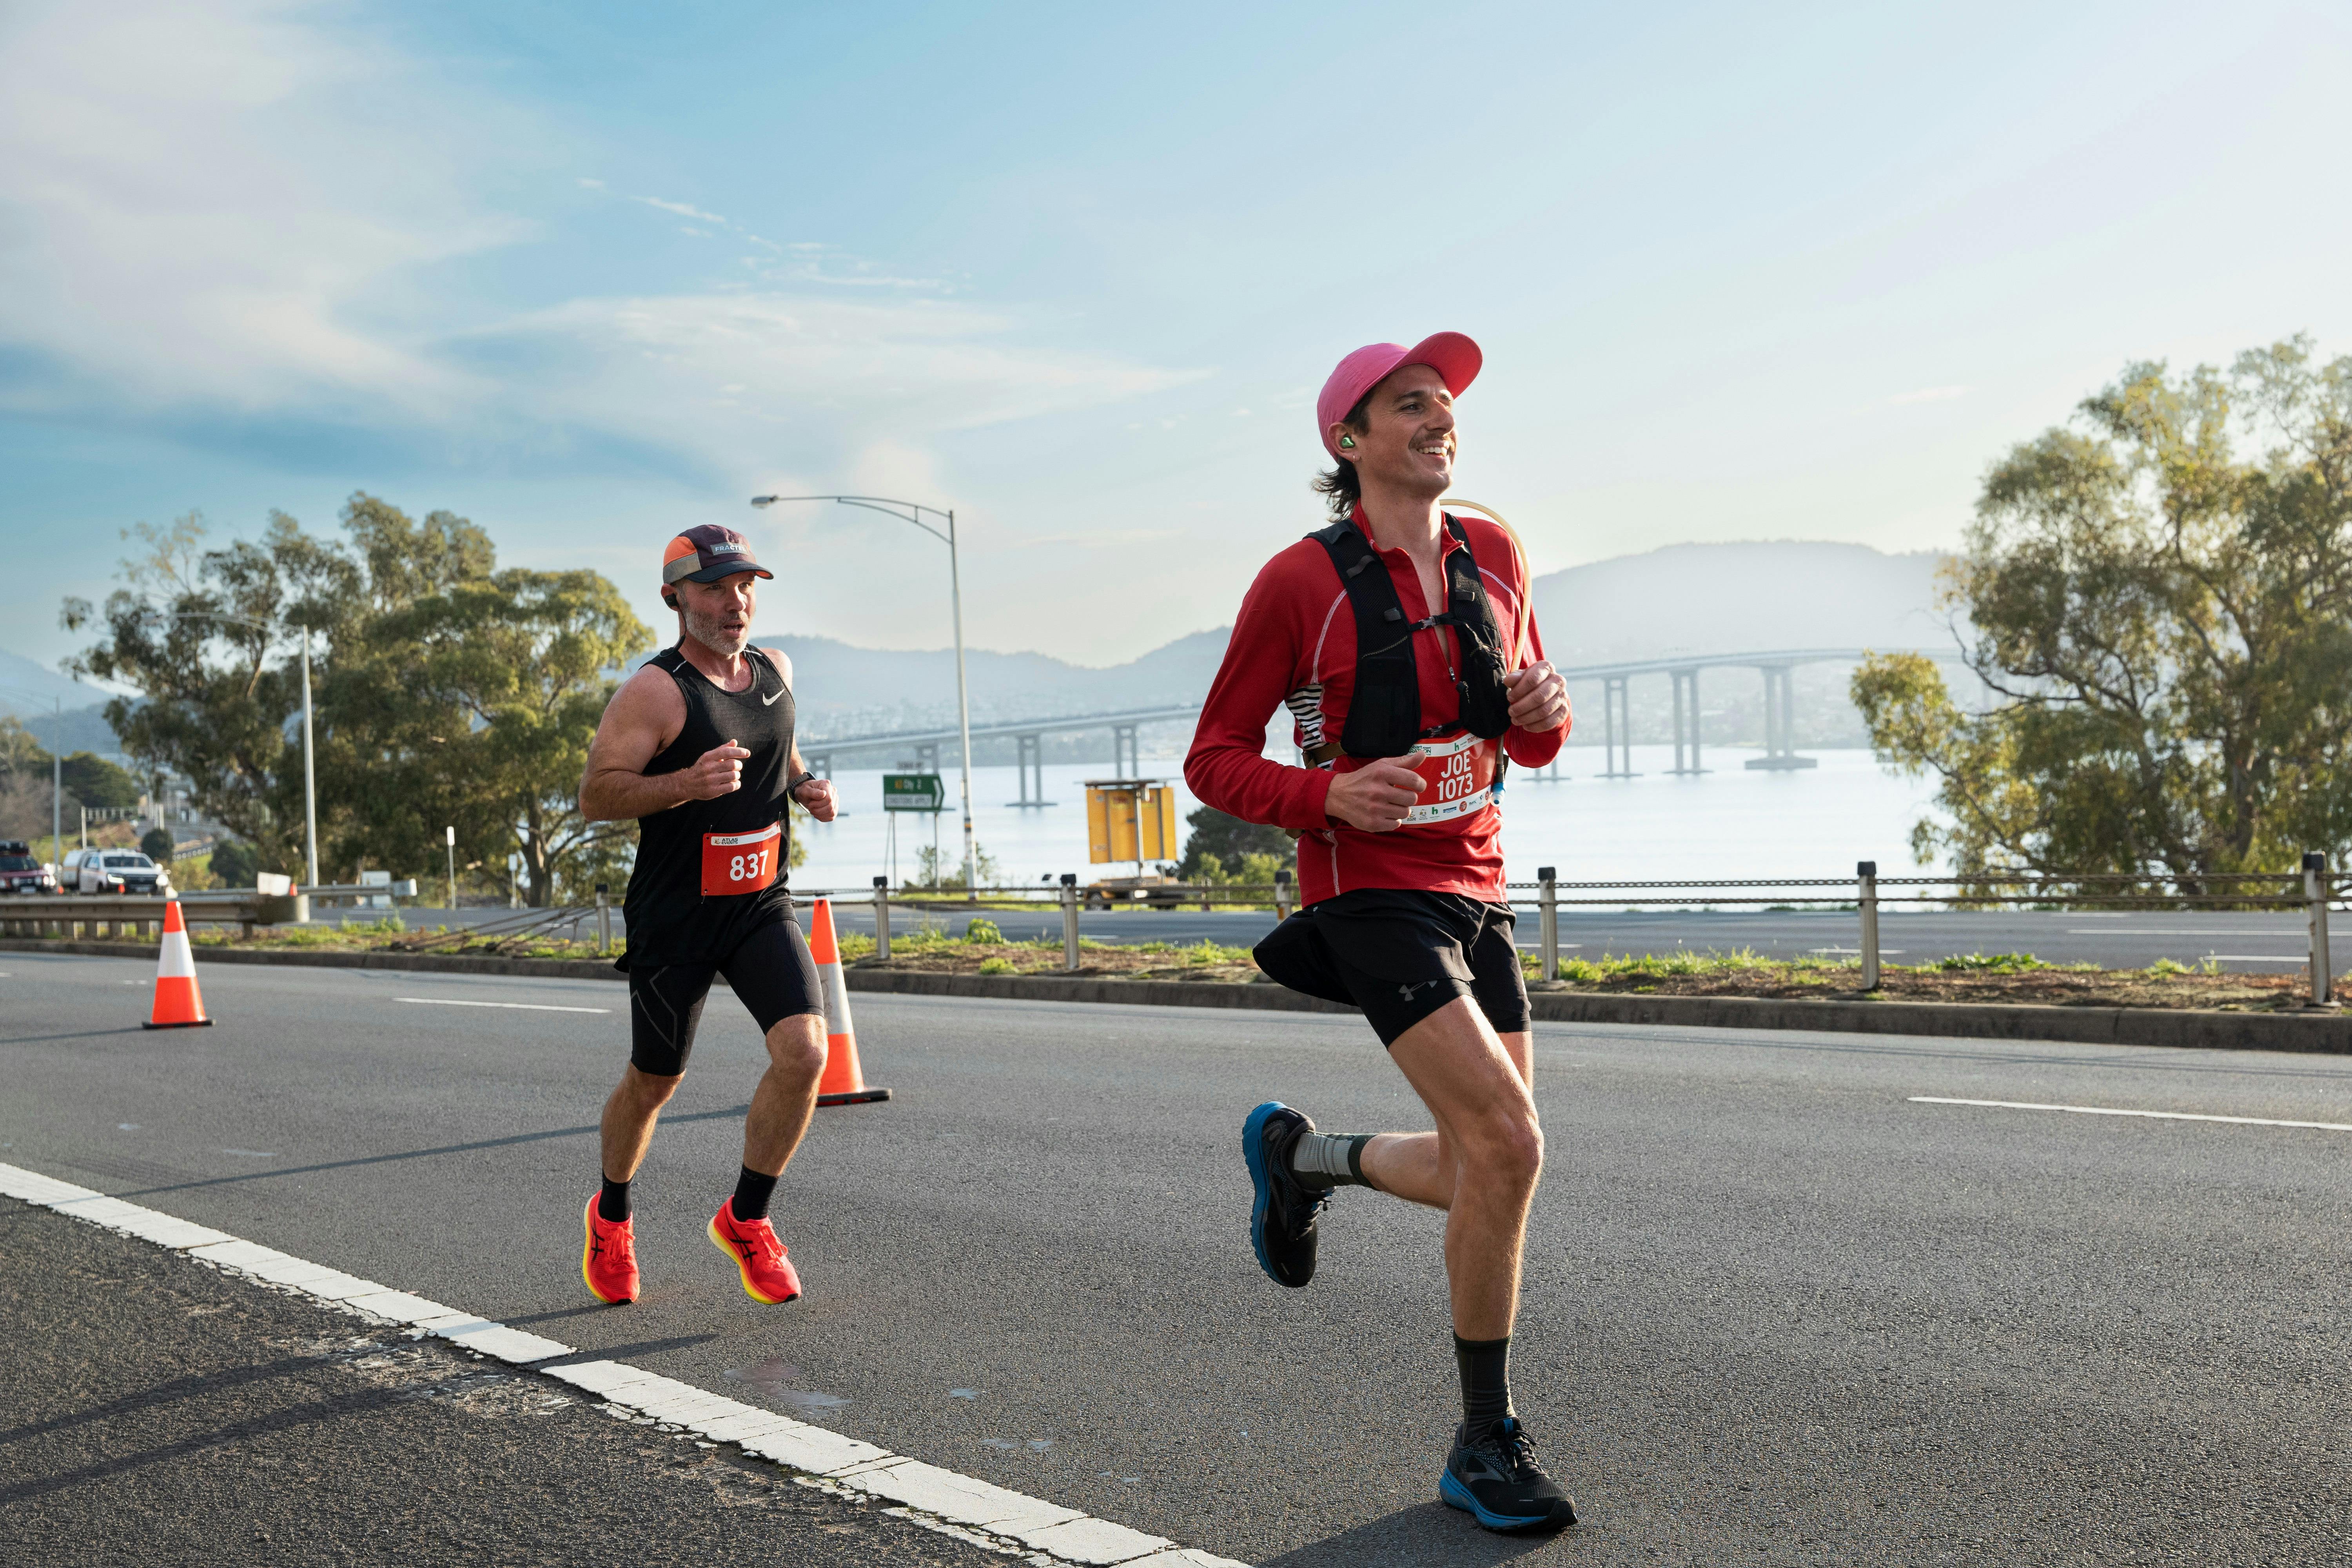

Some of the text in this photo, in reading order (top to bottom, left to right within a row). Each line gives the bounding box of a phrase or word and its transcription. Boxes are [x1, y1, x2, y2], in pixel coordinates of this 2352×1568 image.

[1441, 750, 1471, 778] JOE
[1437, 773, 1473, 801] 1073
[730, 849, 768, 881] 837
